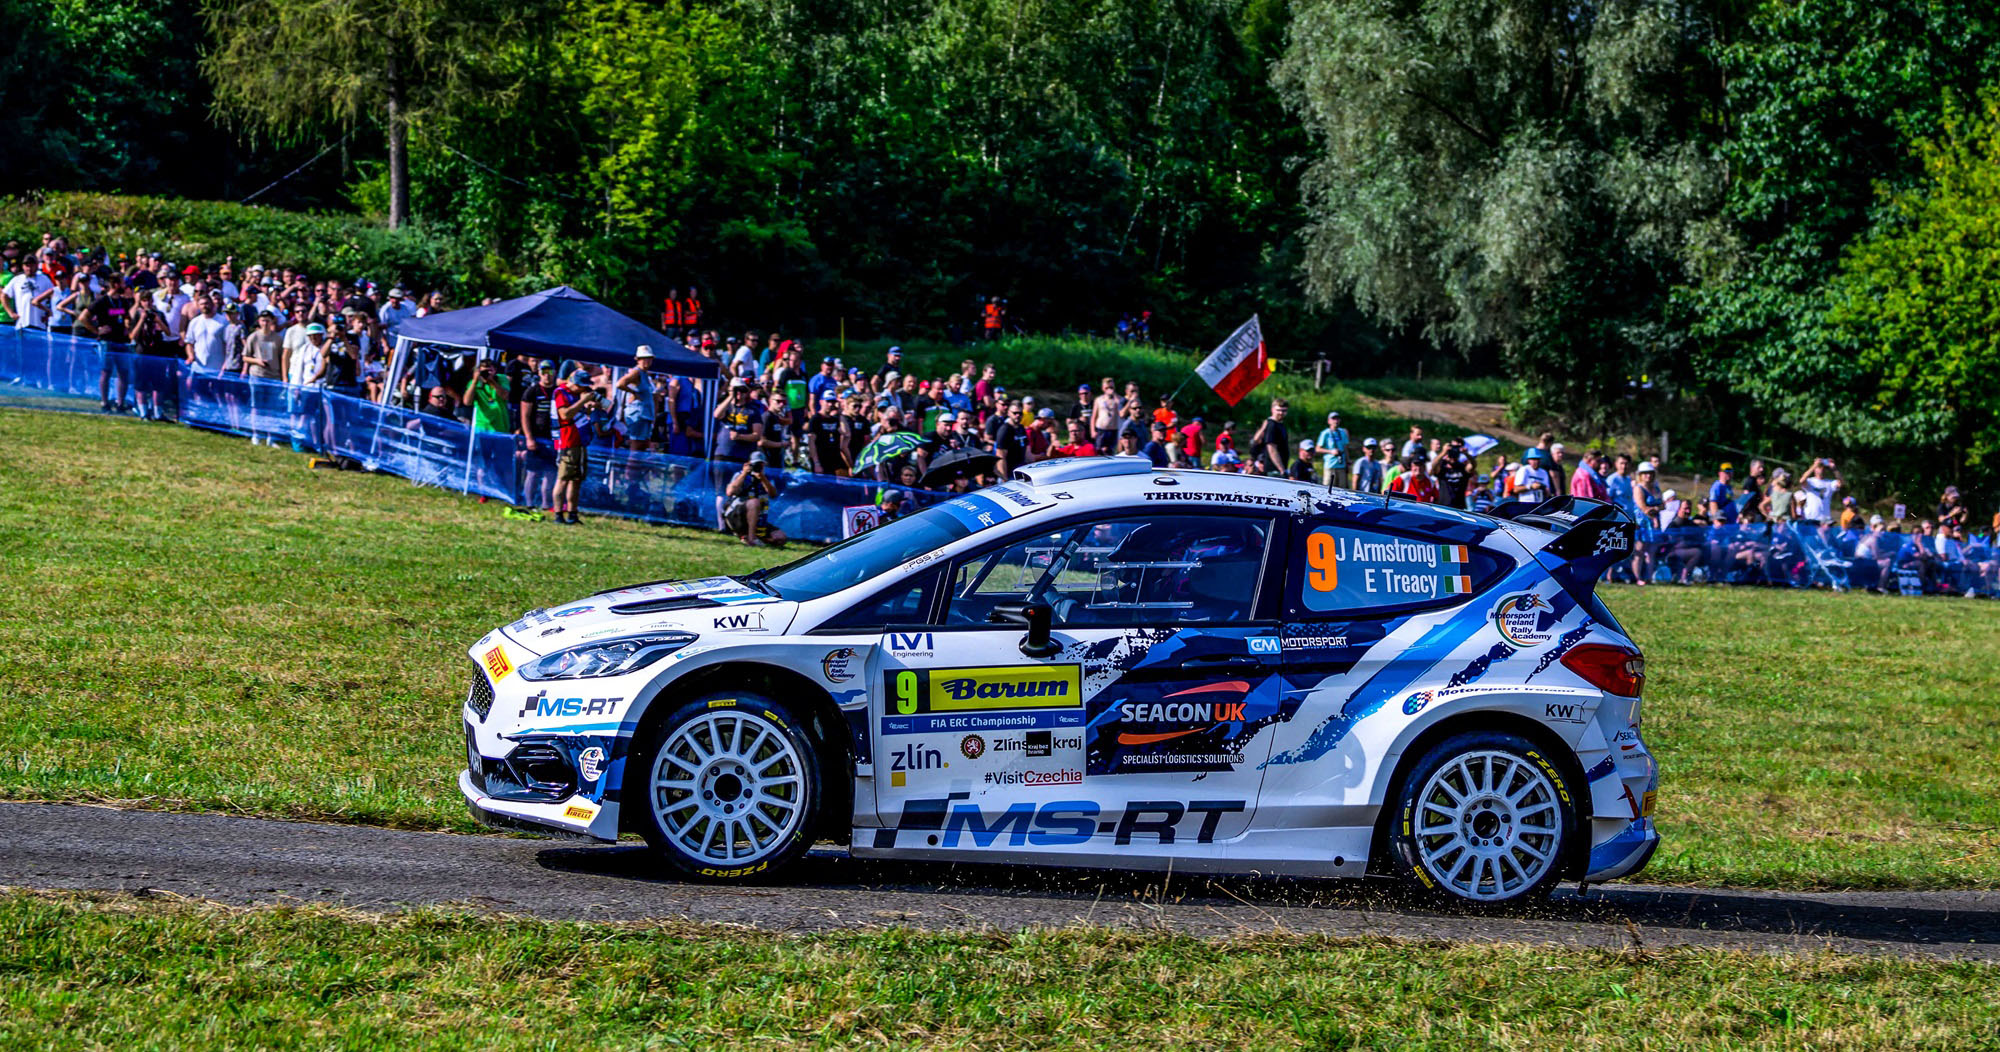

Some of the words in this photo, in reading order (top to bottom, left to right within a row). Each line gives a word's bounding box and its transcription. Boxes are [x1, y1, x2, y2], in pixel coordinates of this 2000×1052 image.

[1143, 491, 1291, 508] THRUSTMASTER
[1335, 537, 1346, 561] J
[1352, 538, 1437, 568] Armstrong
[1306, 532, 1338, 592] 9
[1364, 569, 1377, 592] E
[1382, 569, 1438, 599] Treacy
[713, 615, 750, 629] KW
[1490, 612, 1535, 620] Motorsport
[890, 633, 934, 650] LVI
[1281, 636, 1347, 647] MOTORSPORT
[897, 671, 917, 714] 9
[948, 678, 1069, 700] Barum
[1437, 687, 1519, 698] Motorsport
[536, 696, 624, 717] MS-RT
[1120, 703, 1211, 722] SEACON
[1214, 703, 1247, 721] UK
[1545, 703, 1574, 718] KW
[930, 719, 947, 729] FIA
[950, 717, 968, 727] ERC
[970, 715, 1037, 727] Championship
[1052, 736, 1082, 751] kraj
[984, 769, 1082, 785] #VisitCzechia
[941, 800, 1246, 847] MS-RT
